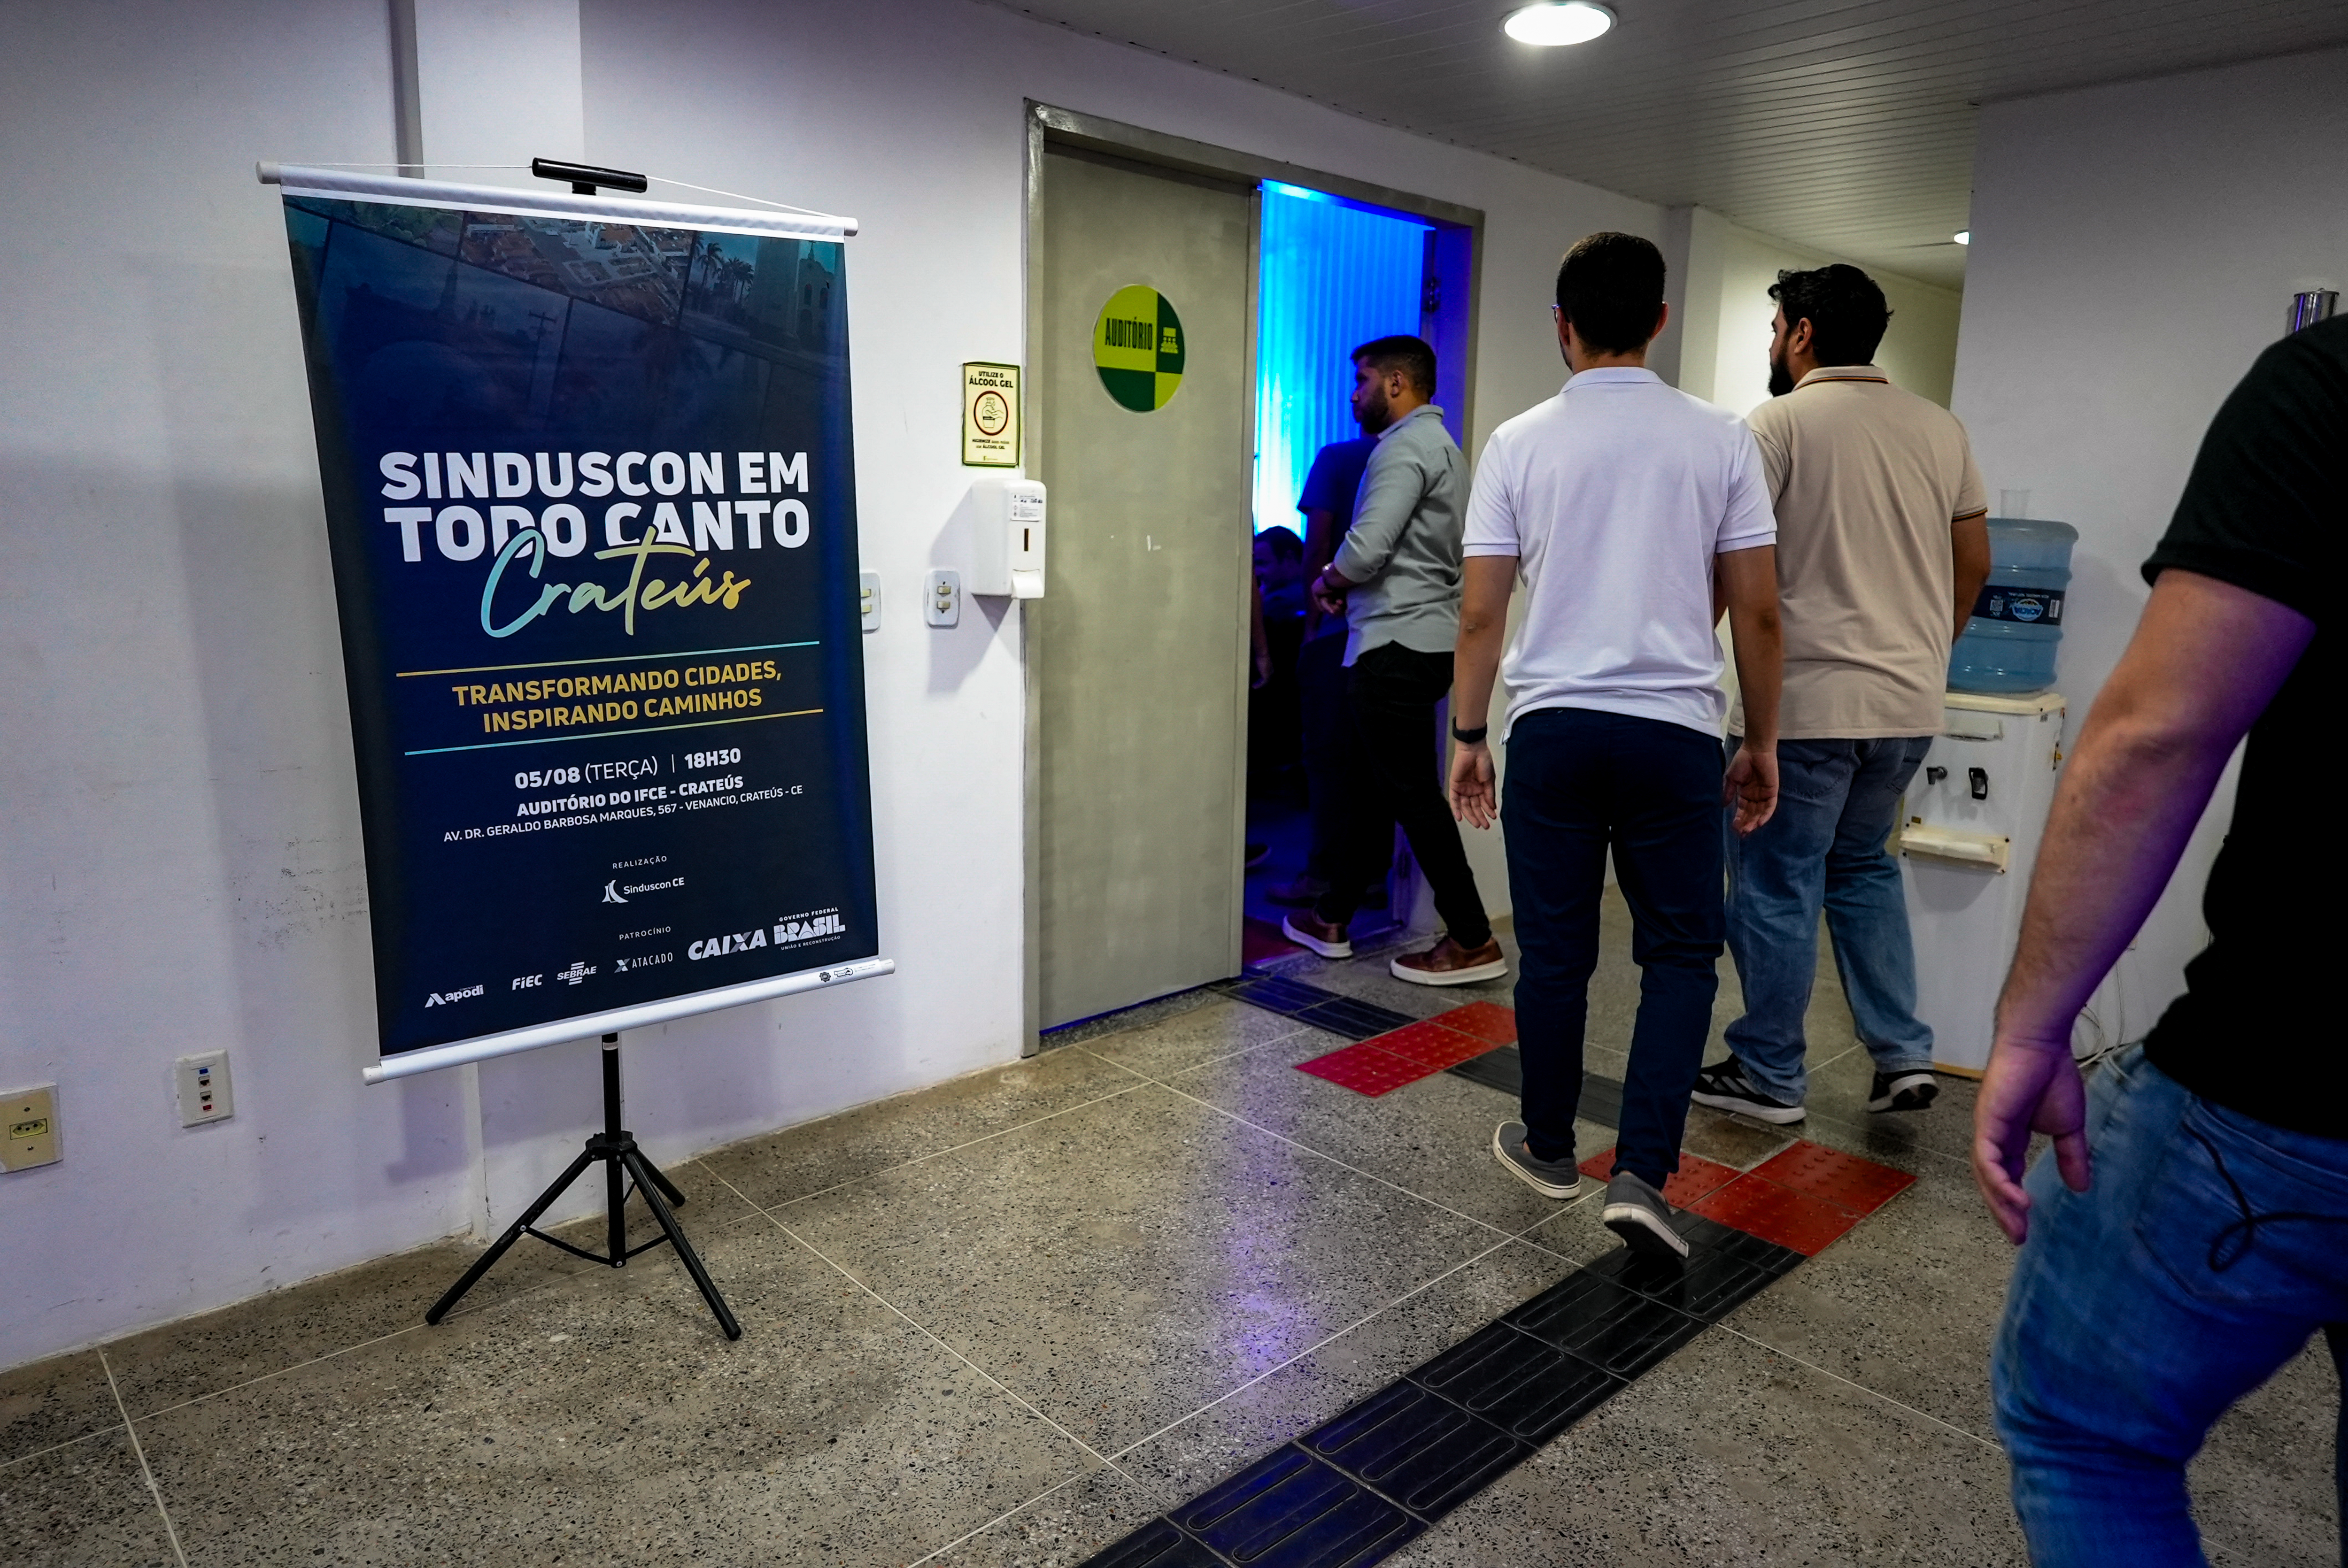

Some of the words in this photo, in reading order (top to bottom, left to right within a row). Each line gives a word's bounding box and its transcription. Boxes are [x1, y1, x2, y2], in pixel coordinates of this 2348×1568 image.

[1105, 316, 1152, 350] AUDITÓRIO
[969, 375, 998, 387] ÁLCOOL
[379, 452, 725, 500] SINDUSCON
[738, 452, 809, 494] EM
[384, 504, 587, 561] TODO
[605, 499, 810, 552] CANTO
[481, 526, 751, 638] Crateús
[452, 670, 679, 706] TRANSFORMANDO
[685, 660, 781, 686] CIDADES,
[483, 698, 638, 733] INSPIRANDO
[644, 688, 762, 717] CAMINHOS
[515, 767, 581, 789] 05/08
[585, 756, 658, 784] (TERÇA)
[684, 747, 741, 769] 18H30
[517, 794, 606, 817] AUDITÓRIO
[609, 791, 631, 805] DO
[634, 786, 667, 802] IFCE
[679, 774, 743, 796] CRATEÚS
[444, 830, 463, 842] AV.
[464, 828, 485, 839] DR.
[487, 821, 541, 836] GERALDO
[544, 814, 598, 830] BARBOSA
[599, 807, 656, 822] MARQUES,
[658, 803, 677, 815] 567
[685, 795, 739, 811] VENANCIO,
[740, 786, 783, 802] CRATEÚS
[791, 785, 803, 795] CE
[612, 855, 667, 869] REALIZAÇÃO
[623, 881, 671, 894] Sinduscon
[672, 877, 685, 886] CE
[773, 914, 846, 945] BRASIL
[779, 912, 809, 922] GOVERNO
[811, 907, 839, 916] FEDERAL
[618, 926, 671, 940] PATROCÍNIO
[688, 929, 767, 961] CAIXA
[803, 935, 841, 946] RECONSTRUÇÃO
[556, 966, 597, 980] SEBRAE
[632, 952, 673, 968] ATACADO
